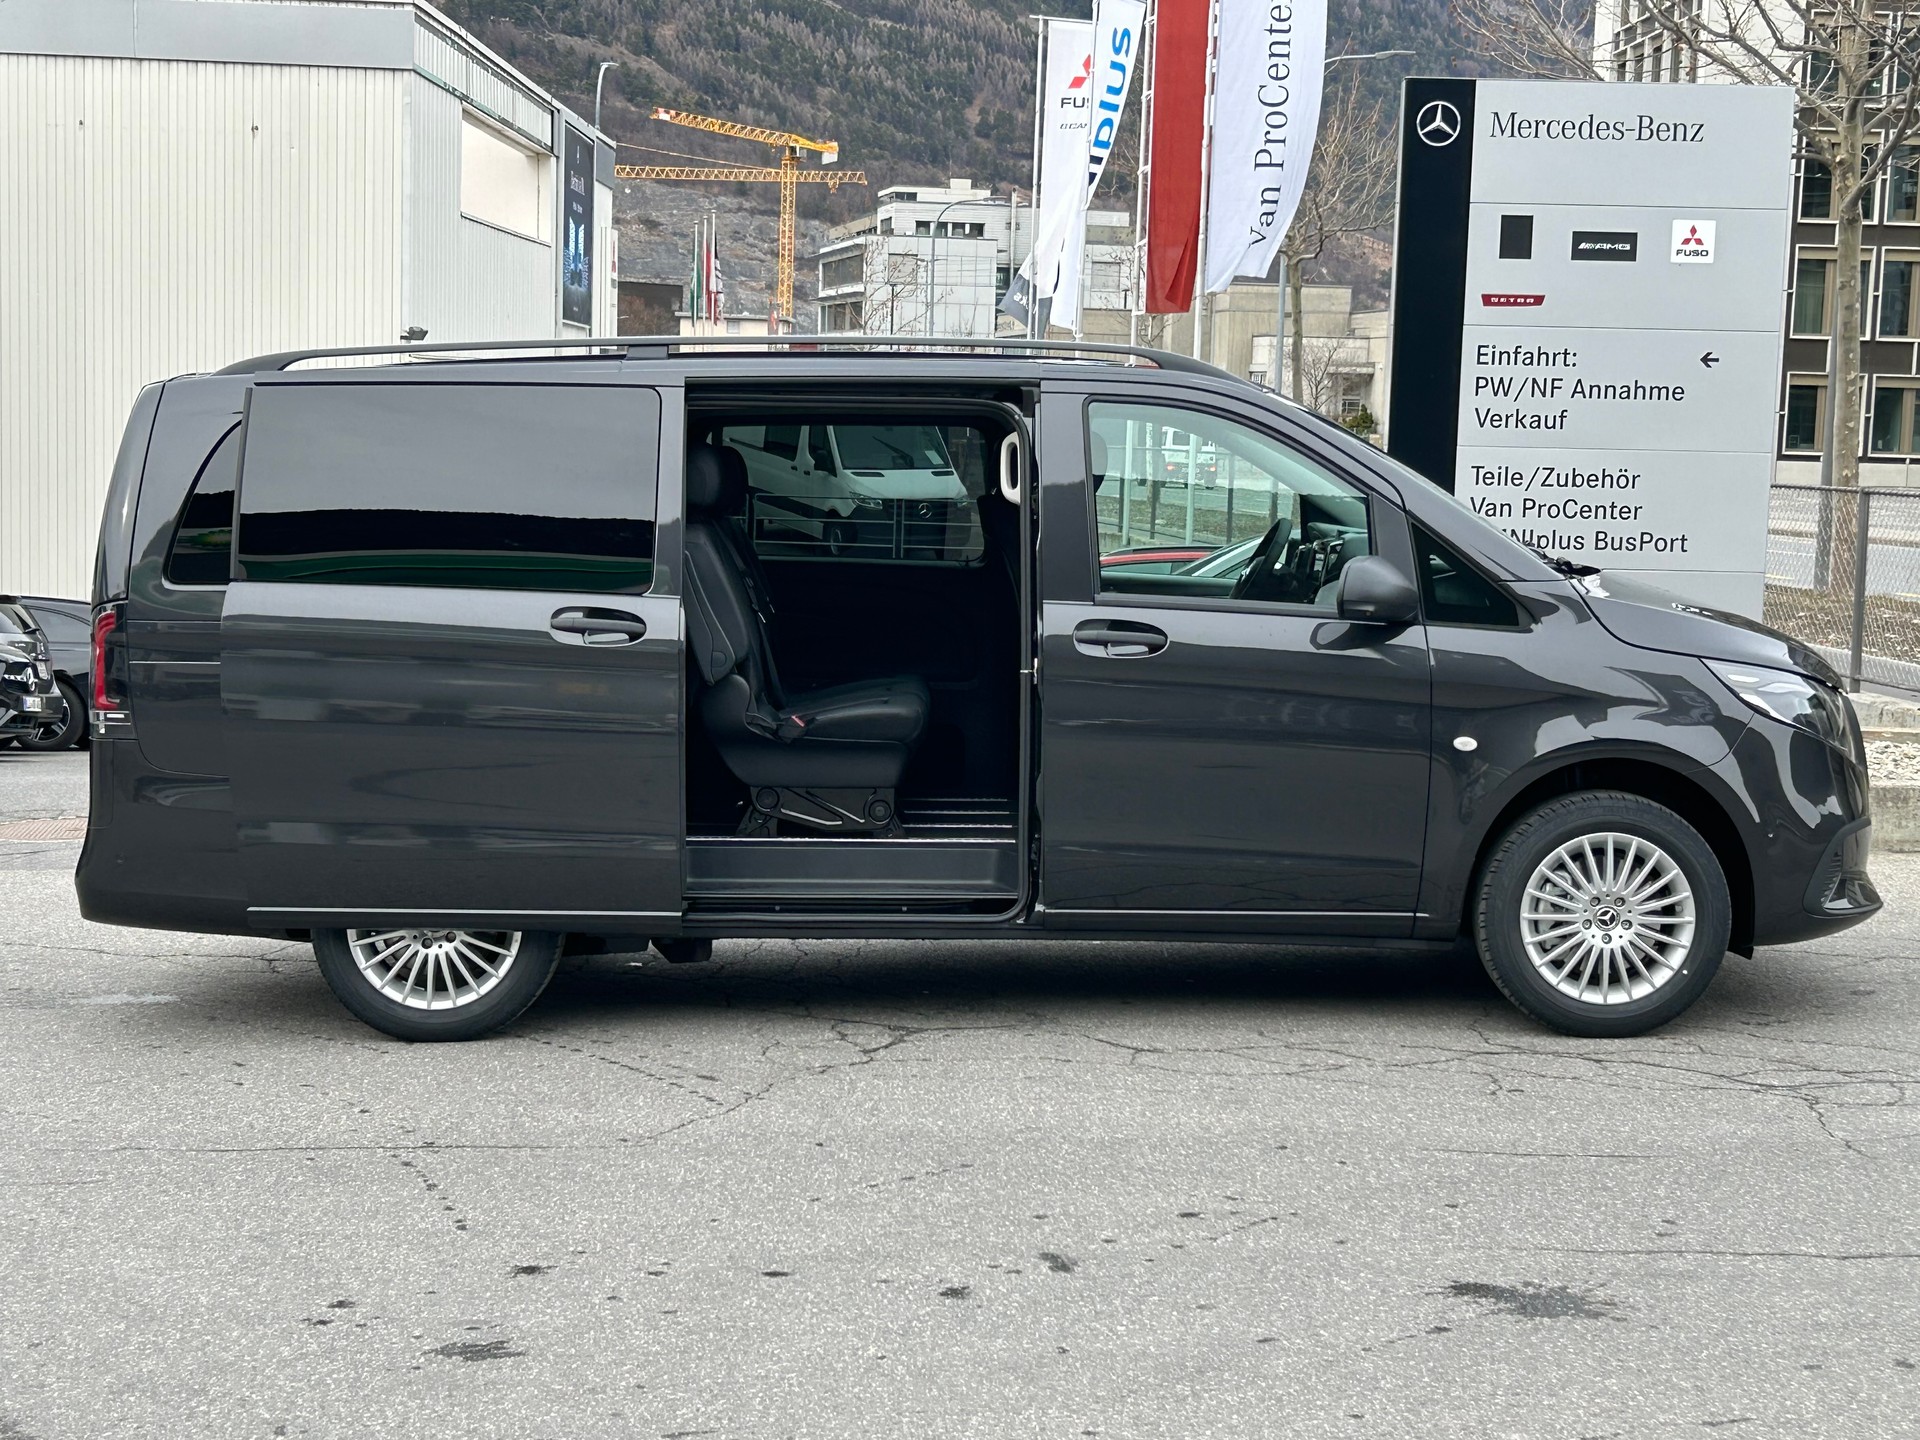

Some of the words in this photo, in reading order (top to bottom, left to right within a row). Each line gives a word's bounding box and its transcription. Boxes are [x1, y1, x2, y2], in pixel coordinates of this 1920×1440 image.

[1253, 0, 1292, 172] ProCente
[1060, 97, 1089, 109] FU
[1087, 27, 1131, 187] Iplus
[1489, 111, 1705, 143] Mercedes-Benz
[1248, 184, 1281, 249] Van
[1594, 242, 1631, 251] AMG
[1675, 249, 1709, 257] FUSO
[1476, 344, 1577, 368] Einfahrt:
[1474, 376, 1564, 403] PW/NF
[1570, 378, 1685, 402] Annahme
[1474, 407, 1569, 430] Verkauf
[1470, 465, 1641, 492] Teile/Zubehör
[1469, 496, 1512, 518] Van
[1522, 497, 1643, 521] ProCenter
[1502, 528, 1585, 550] NIplus
[1594, 530, 1688, 553] BusPort
